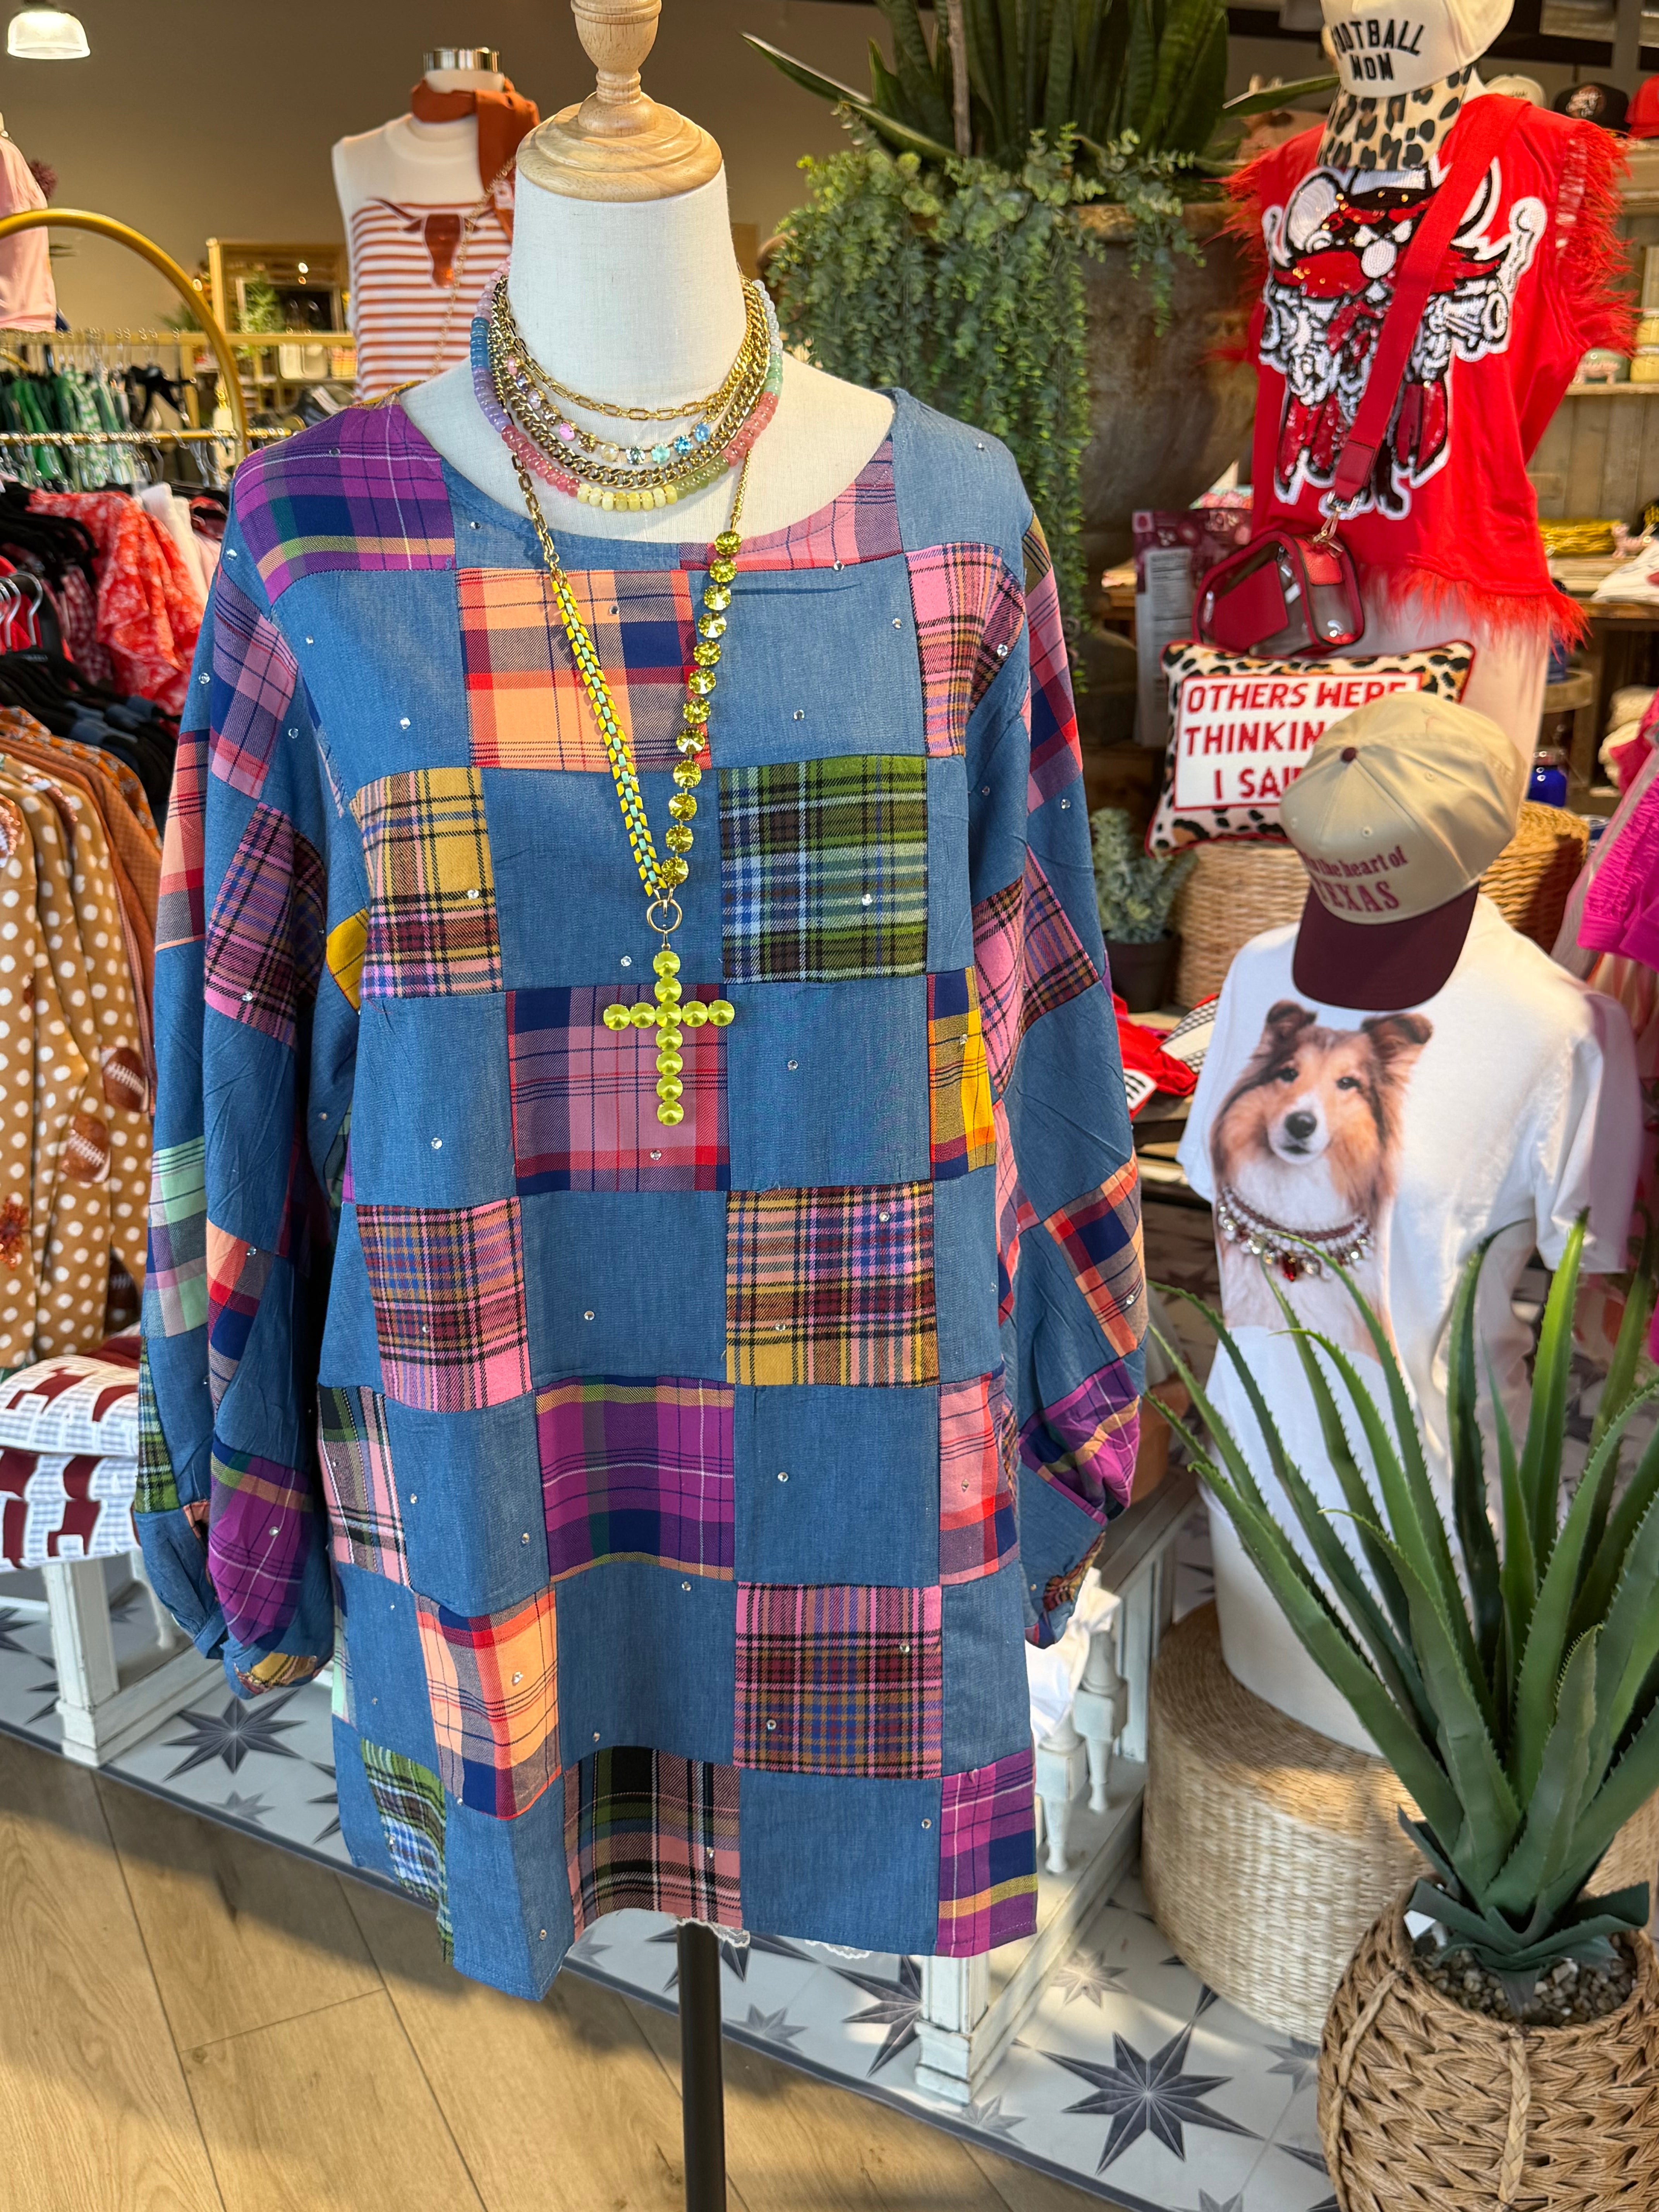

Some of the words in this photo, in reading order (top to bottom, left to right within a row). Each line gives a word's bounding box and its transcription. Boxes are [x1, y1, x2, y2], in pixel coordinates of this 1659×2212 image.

[1349, 52, 1394, 81] MOM
[1187, 683, 1309, 713] OTHERS
[1315, 682, 1407, 708] WER
[1214, 768, 1223, 800] I
[1238, 766, 1304, 799] SAI
[1338, 854, 1389, 878] heart
[1388, 845, 1408, 868] of
